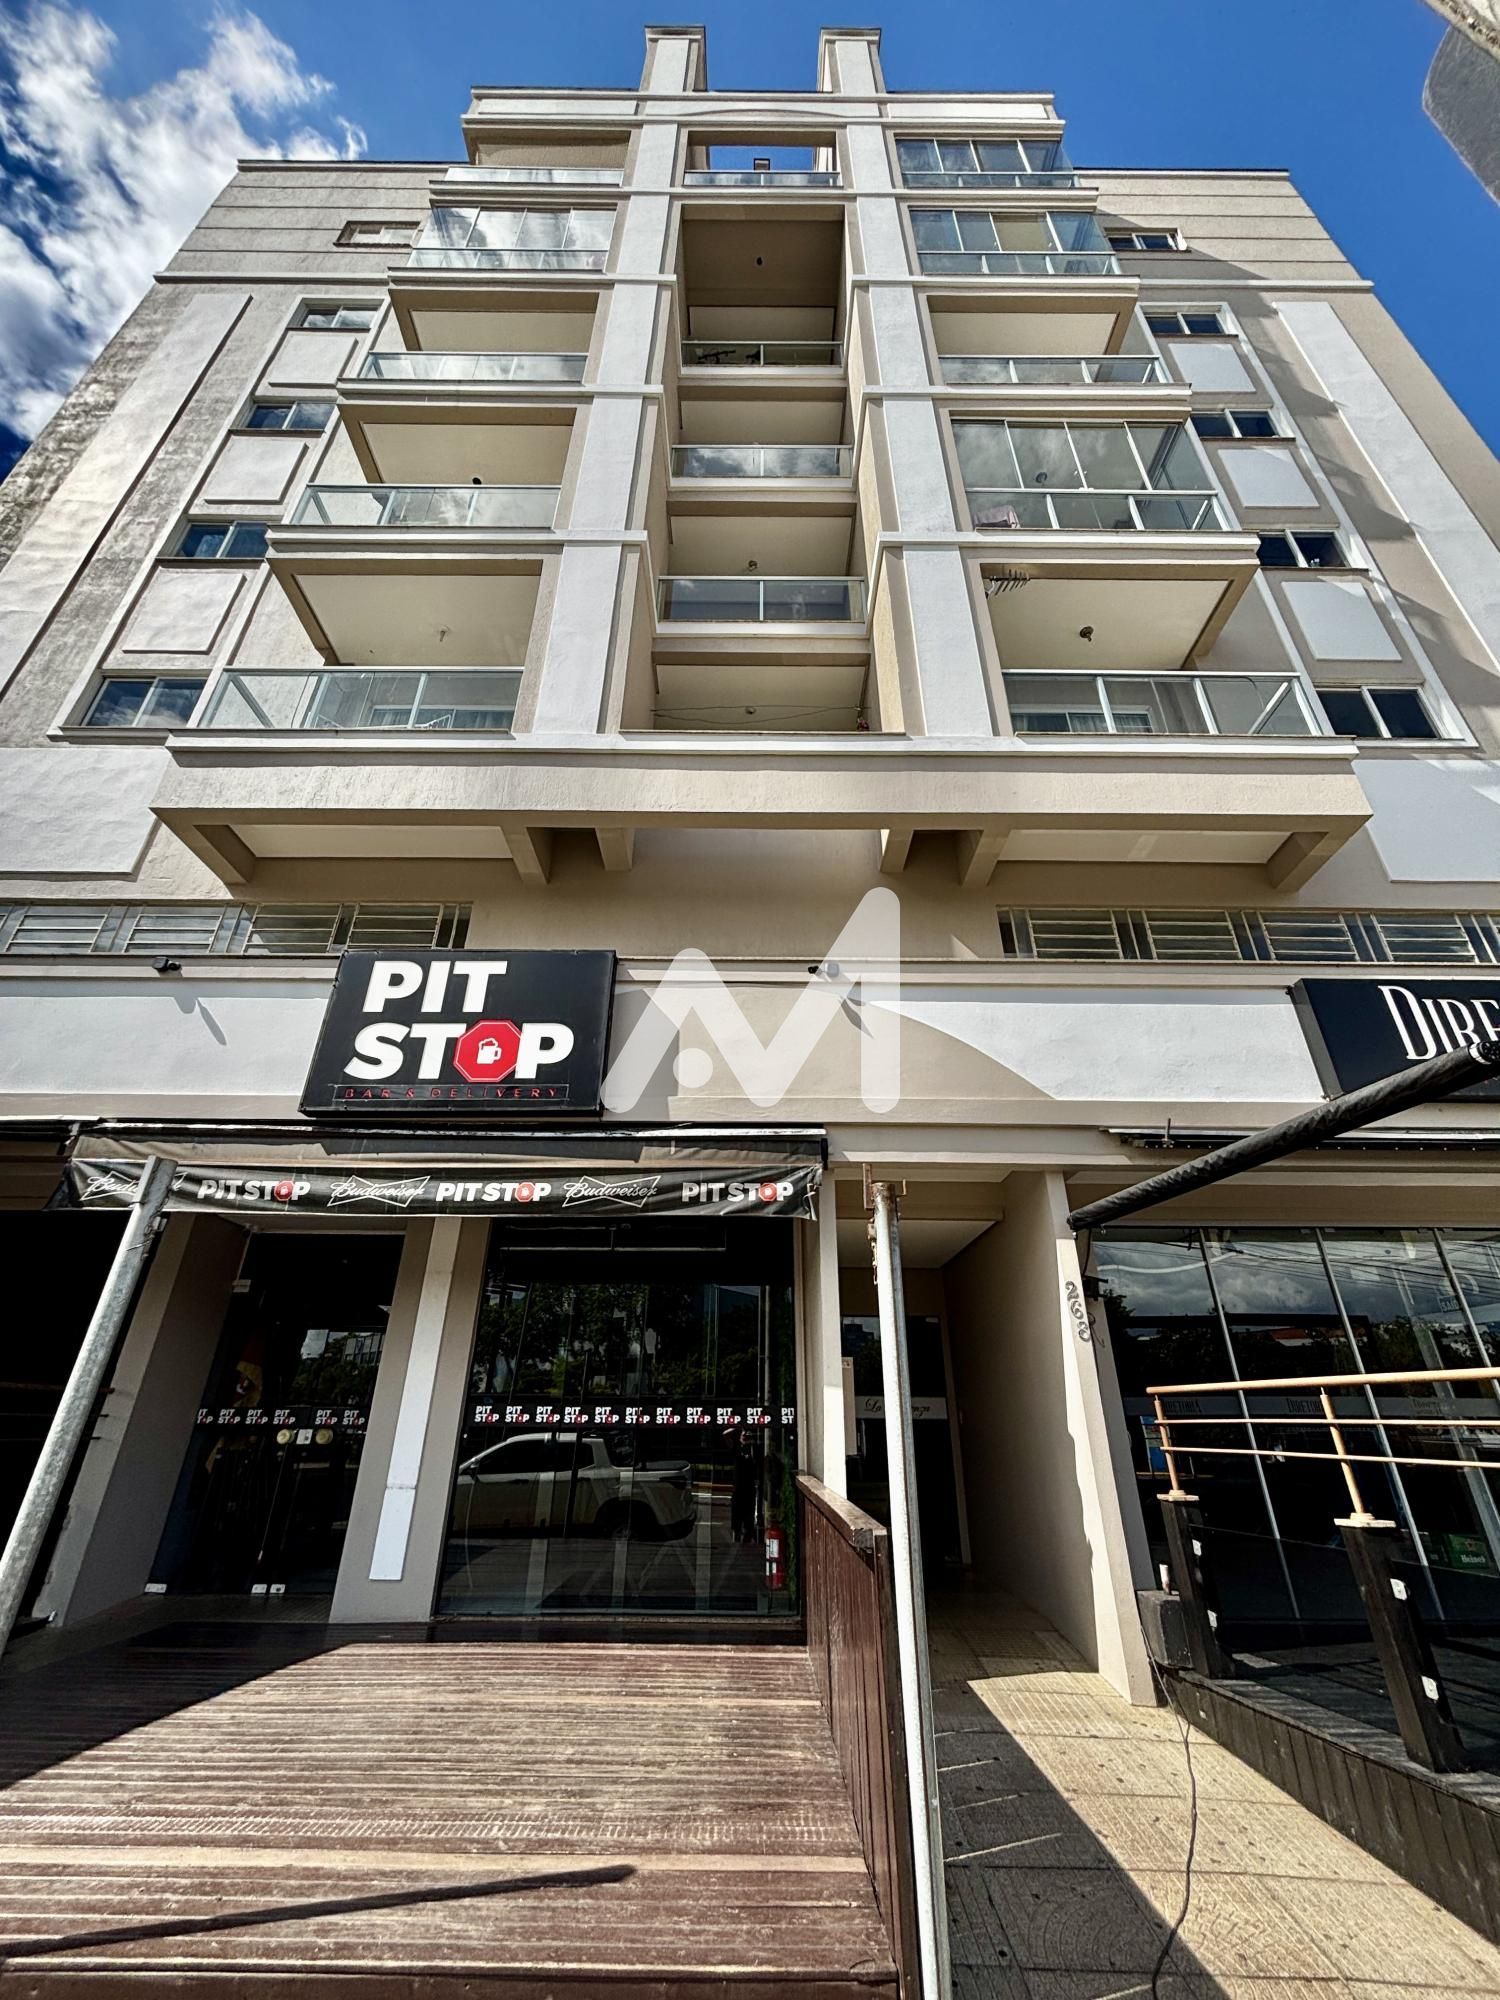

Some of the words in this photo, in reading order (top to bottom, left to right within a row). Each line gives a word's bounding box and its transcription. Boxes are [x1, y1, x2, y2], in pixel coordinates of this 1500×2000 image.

[362, 960, 508, 1013] PIT
[343, 1020, 575, 1083] STOP
[344, 1088, 391, 1098] BAR
[405, 1088, 415, 1098] &
[430, 1088, 558, 1098] DELIVERY
[331, 1181, 425, 1199] Budweiser
[563, 1180, 657, 1199] Budweiser
[475, 1406, 492, 1414] PIT
[505, 1406, 522, 1414] PIT
[536, 1406, 553, 1414] PIT
[564, 1407, 581, 1415] PIT
[594, 1407, 611, 1415] PIT
[625, 1407, 642, 1415] PIT
[656, 1407, 673, 1416] PIT
[686, 1407, 703, 1416] PIT
[716, 1408, 733, 1416] PIT
[746, 1408, 763, 1416] PIT
[196, 1416, 213, 1424] TOP
[217, 1416, 241, 1424] STOP
[245, 1416, 268, 1424] STOP
[272, 1416, 296, 1425] STOP
[315, 1417, 338, 1425] STOP
[342, 1417, 365, 1425] STOP
[474, 1414, 499, 1423] STOP
[504, 1414, 530, 1423] STOP
[535, 1414, 560, 1423] STOP
[563, 1414, 588, 1423] STOP
[594, 1415, 619, 1423] STOP
[625, 1415, 650, 1424] STOP
[655, 1415, 681, 1424] STOP
[686, 1416, 711, 1424] STOP
[716, 1416, 741, 1424] STOP
[746, 1416, 771, 1424] STOP
[781, 1416, 794, 1424] ST
